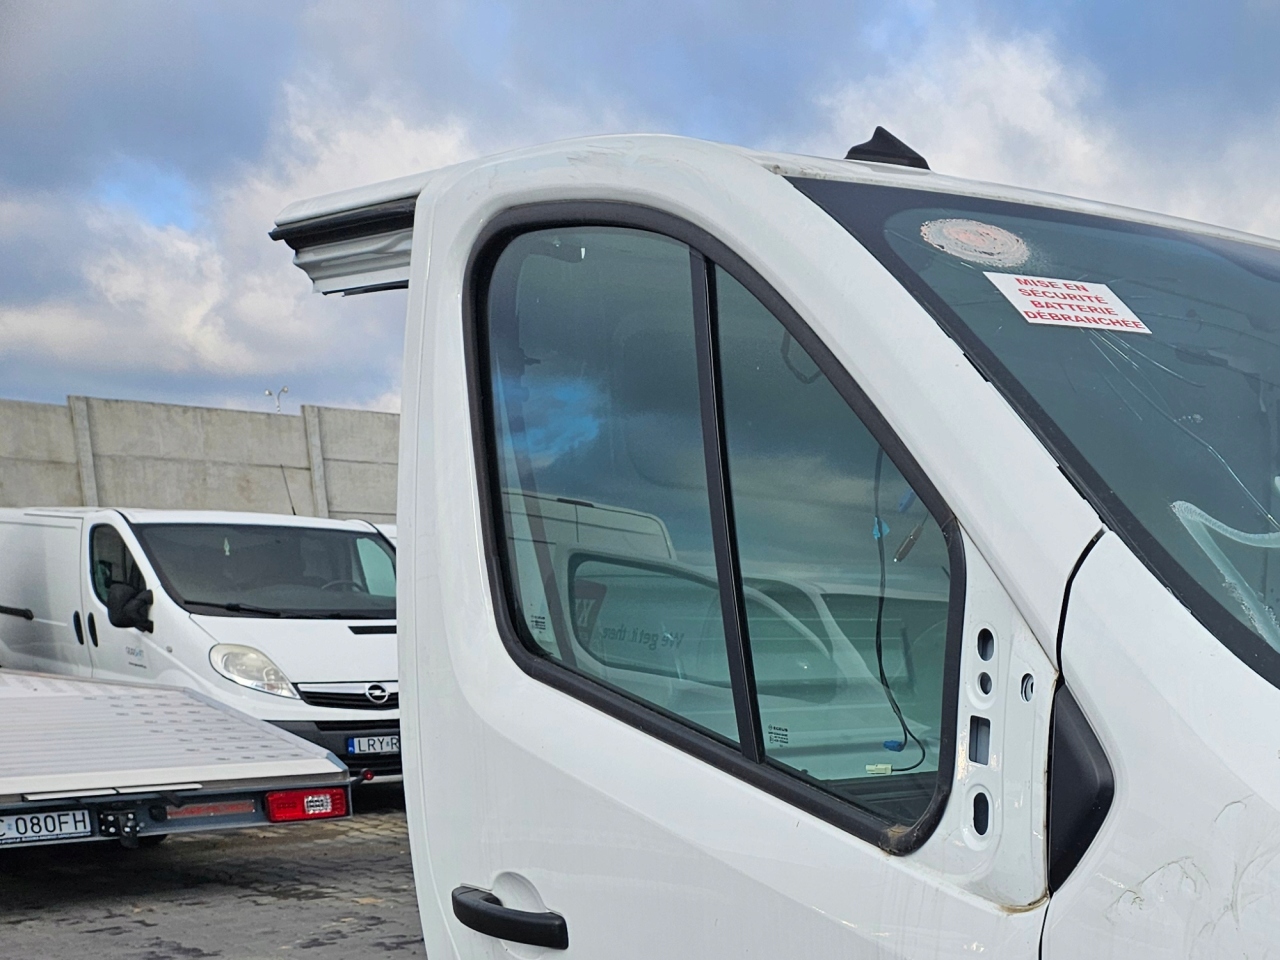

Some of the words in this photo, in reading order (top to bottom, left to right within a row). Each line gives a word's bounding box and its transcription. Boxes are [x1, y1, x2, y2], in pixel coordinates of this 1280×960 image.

[1014, 277, 1063, 290] MISE
[1063, 282, 1090, 293] EN
[1017, 288, 1109, 305] SÉCURITÉ
[1030, 300, 1119, 316] BATTERIE
[1023, 310, 1146, 330] DÉBRANCHÉE
[357, 737, 385, 752] LRY
[15, 811, 88, 836] 080FH
